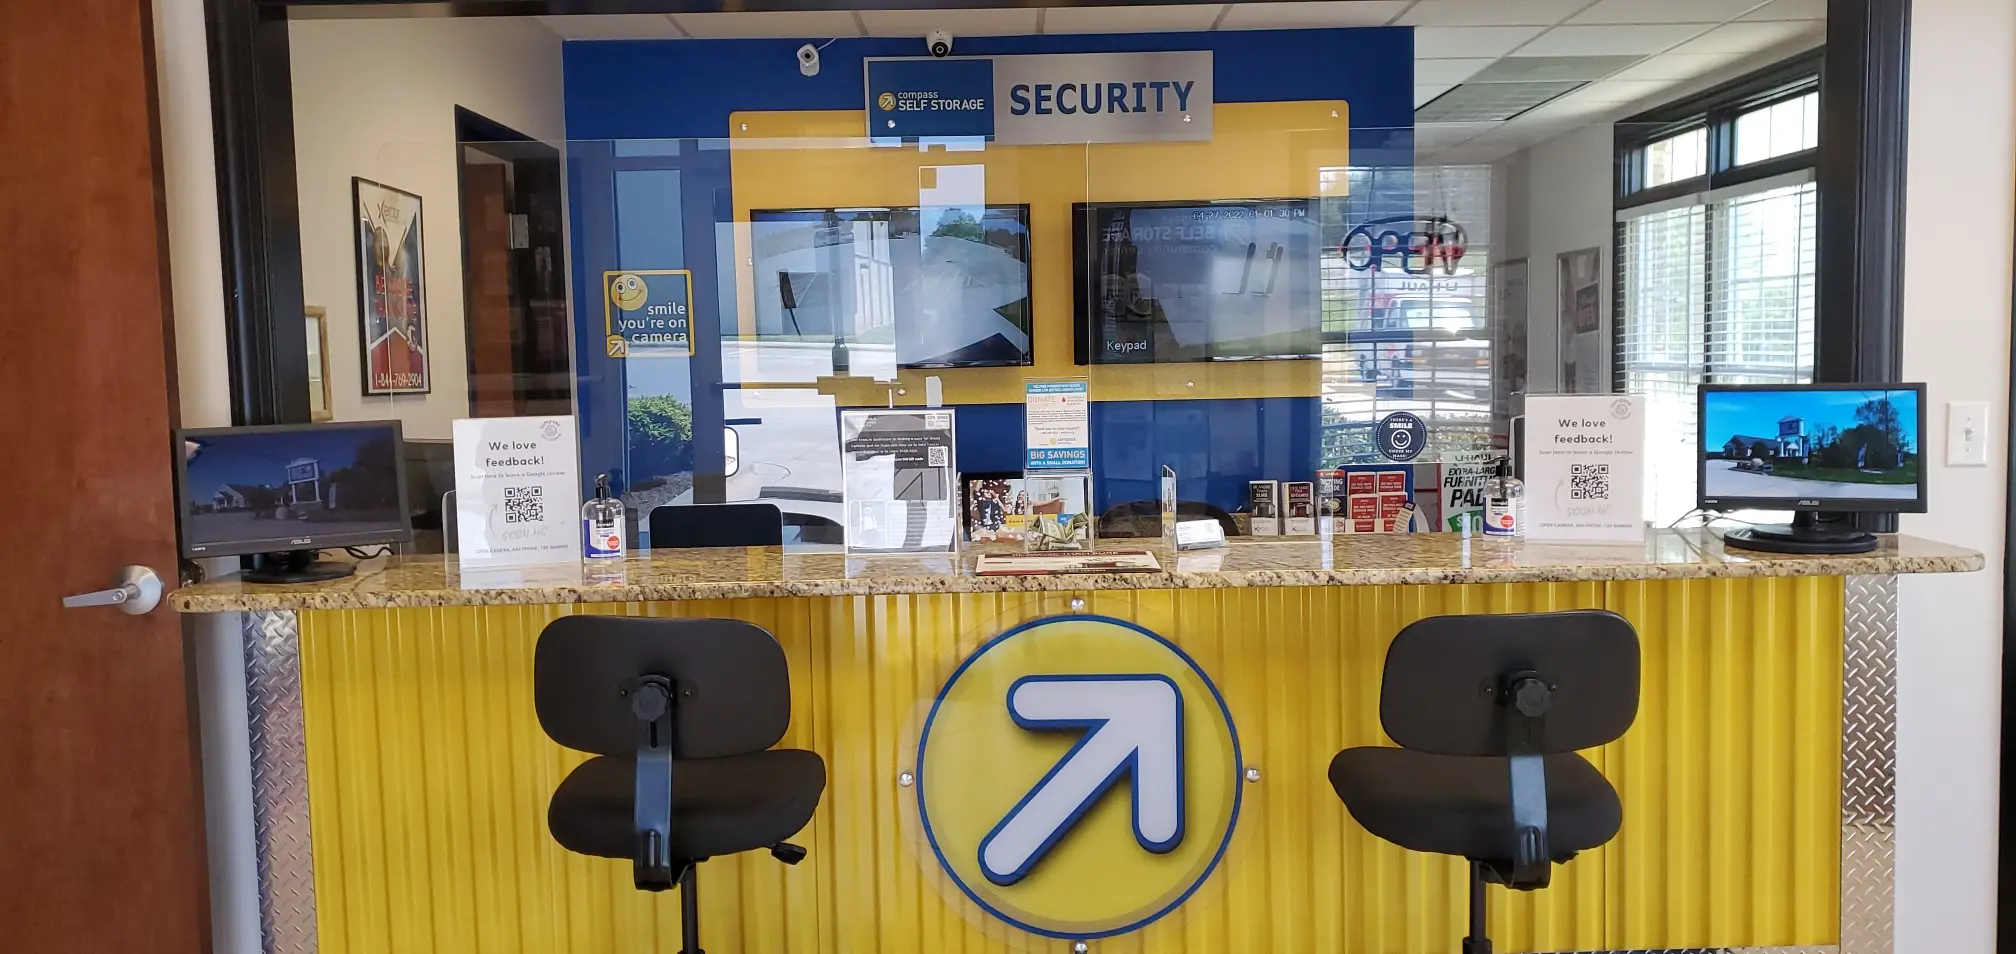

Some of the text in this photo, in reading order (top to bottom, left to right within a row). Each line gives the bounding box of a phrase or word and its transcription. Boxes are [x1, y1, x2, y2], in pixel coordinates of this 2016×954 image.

[898, 90, 939, 101] compass
[1010, 80, 1195, 116] SECURITY
[898, 98, 985, 112] SELF STORAGE
[647, 302, 686, 315] smile
[619, 316, 687, 332] you're on
[632, 332, 687, 343] camera
[1107, 339, 1147, 353] Keypad
[1558, 418, 1606, 428] We love
[1554, 434, 1613, 444] feedback!
[488, 440, 537, 451] We love
[1030, 450, 1085, 459] BIG SAVINGS
[485, 455, 545, 468] feedback!
[1448, 466, 1497, 476] EXTRA-LARG
